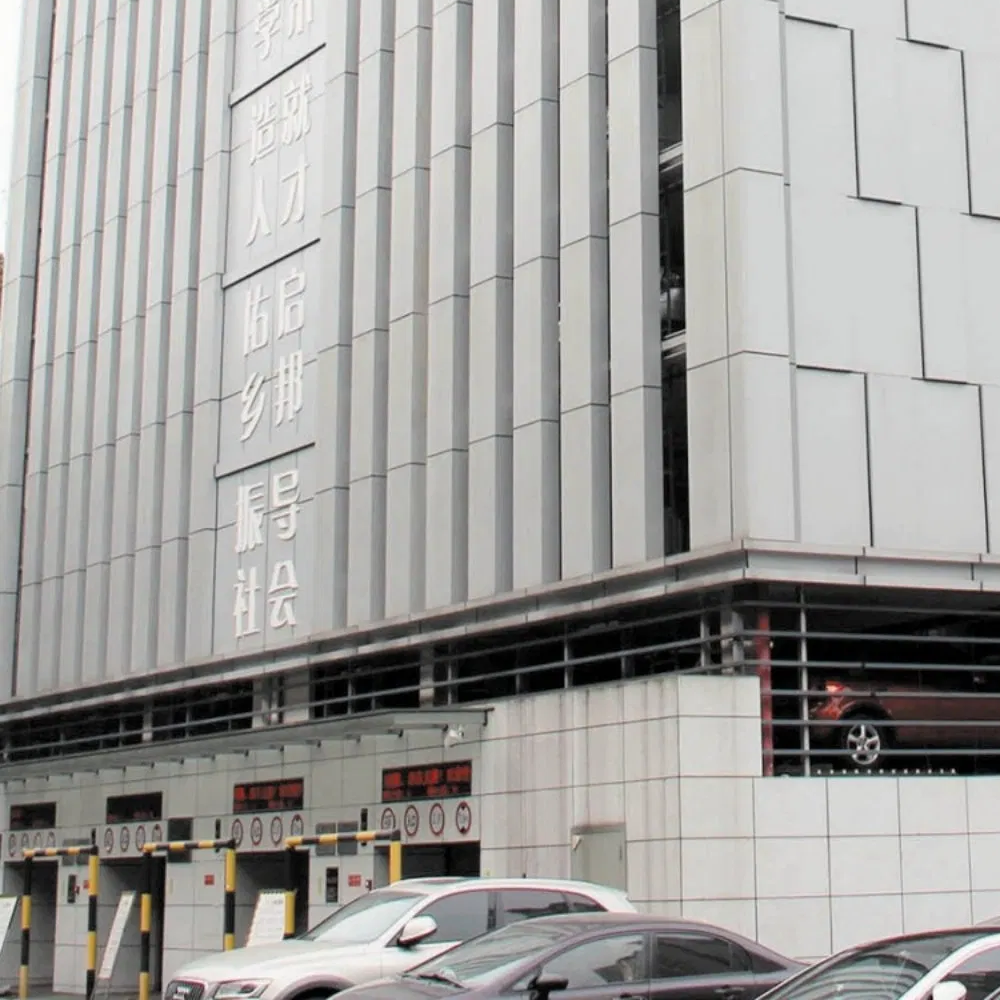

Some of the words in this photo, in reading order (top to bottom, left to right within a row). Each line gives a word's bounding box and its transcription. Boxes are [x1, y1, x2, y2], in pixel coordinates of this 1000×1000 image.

[249, 73, 313, 166] 造就
[245, 153, 312, 248] 人才
[244, 267, 307, 357] 佑启
[240, 349, 304, 442] 乡邦
[235, 468, 302, 554] 振导
[232, 558, 301, 637] 社会
